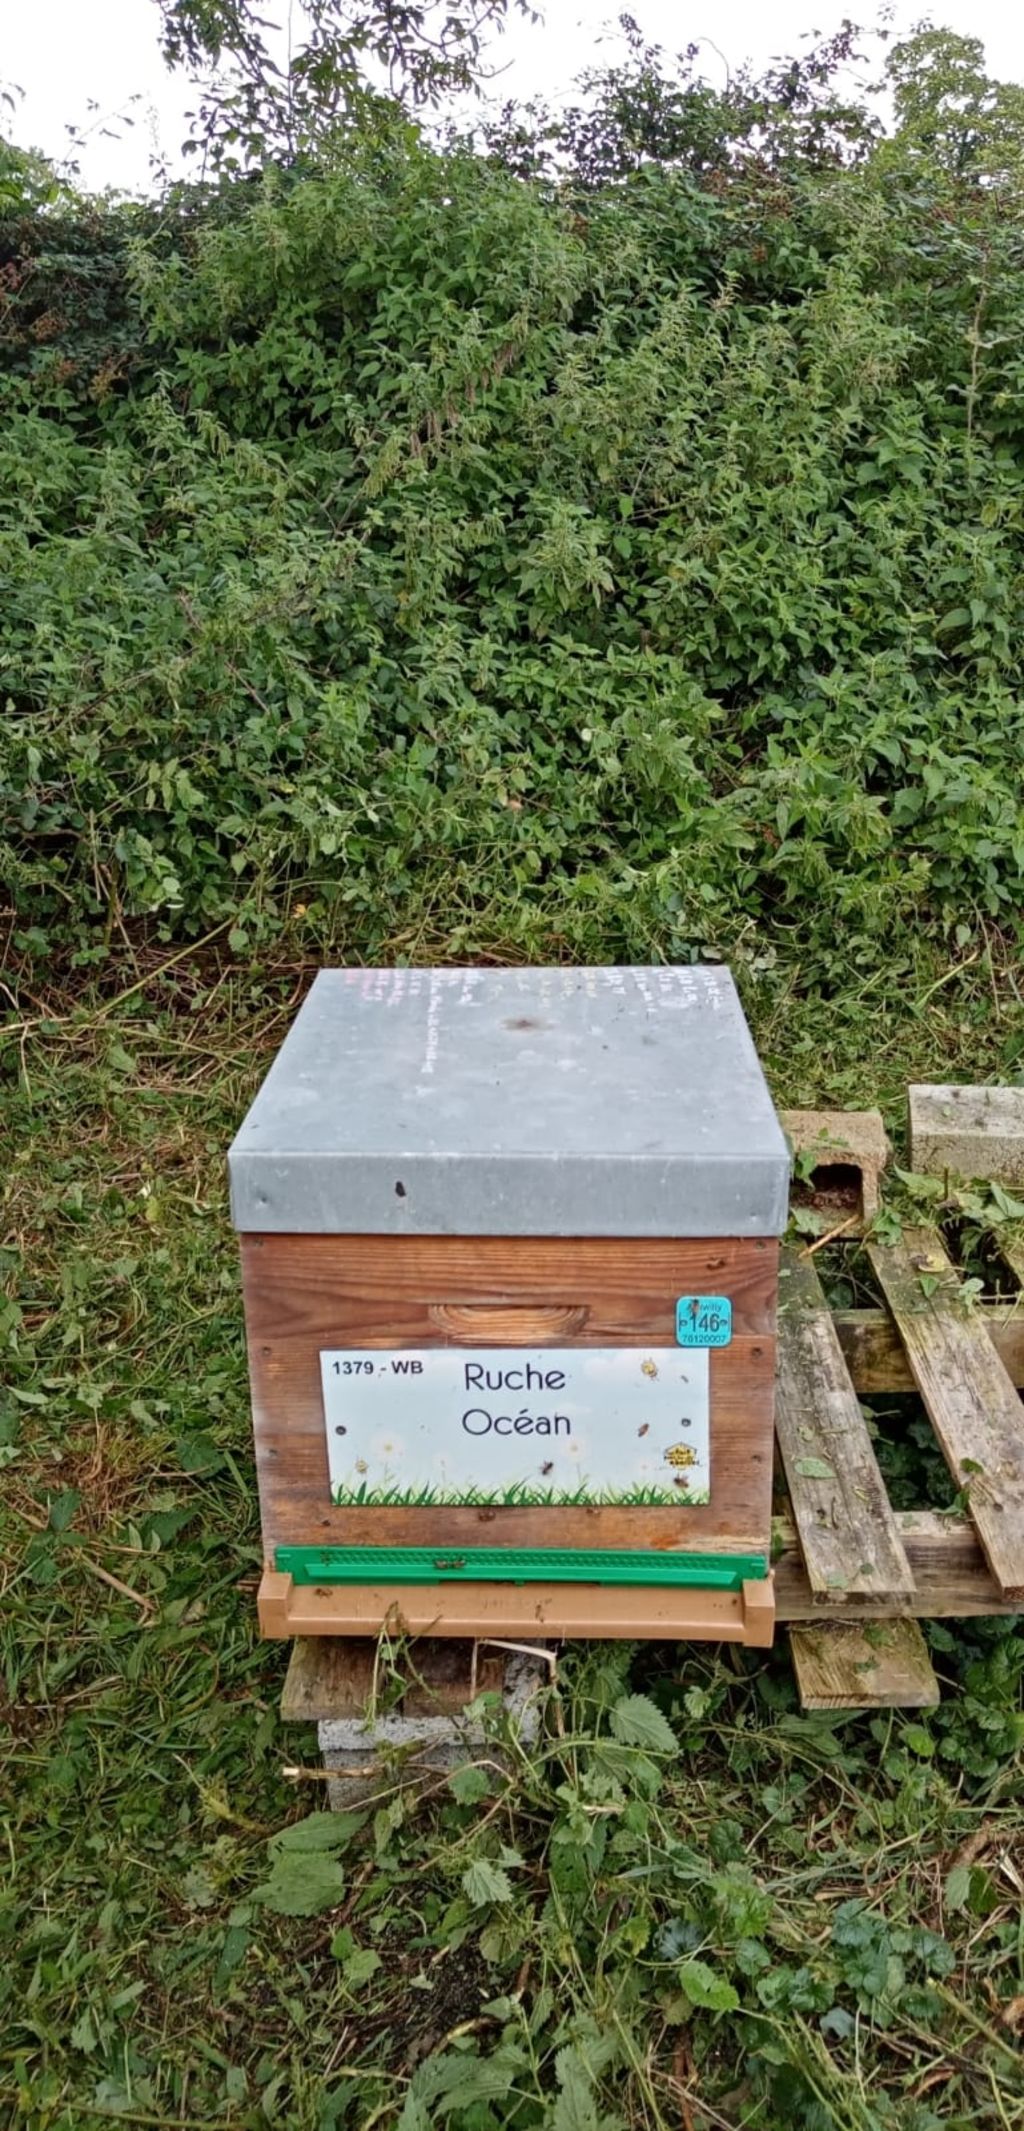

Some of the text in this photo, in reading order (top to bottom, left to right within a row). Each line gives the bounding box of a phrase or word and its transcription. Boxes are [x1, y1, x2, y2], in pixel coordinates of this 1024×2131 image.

[689, 1313, 720, 1332] 146
[333, 1361, 374, 1375] 1379
[391, 1360, 424, 1374] WB
[465, 1363, 566, 1390] Ruche
[462, 1408, 571, 1436] Océan
